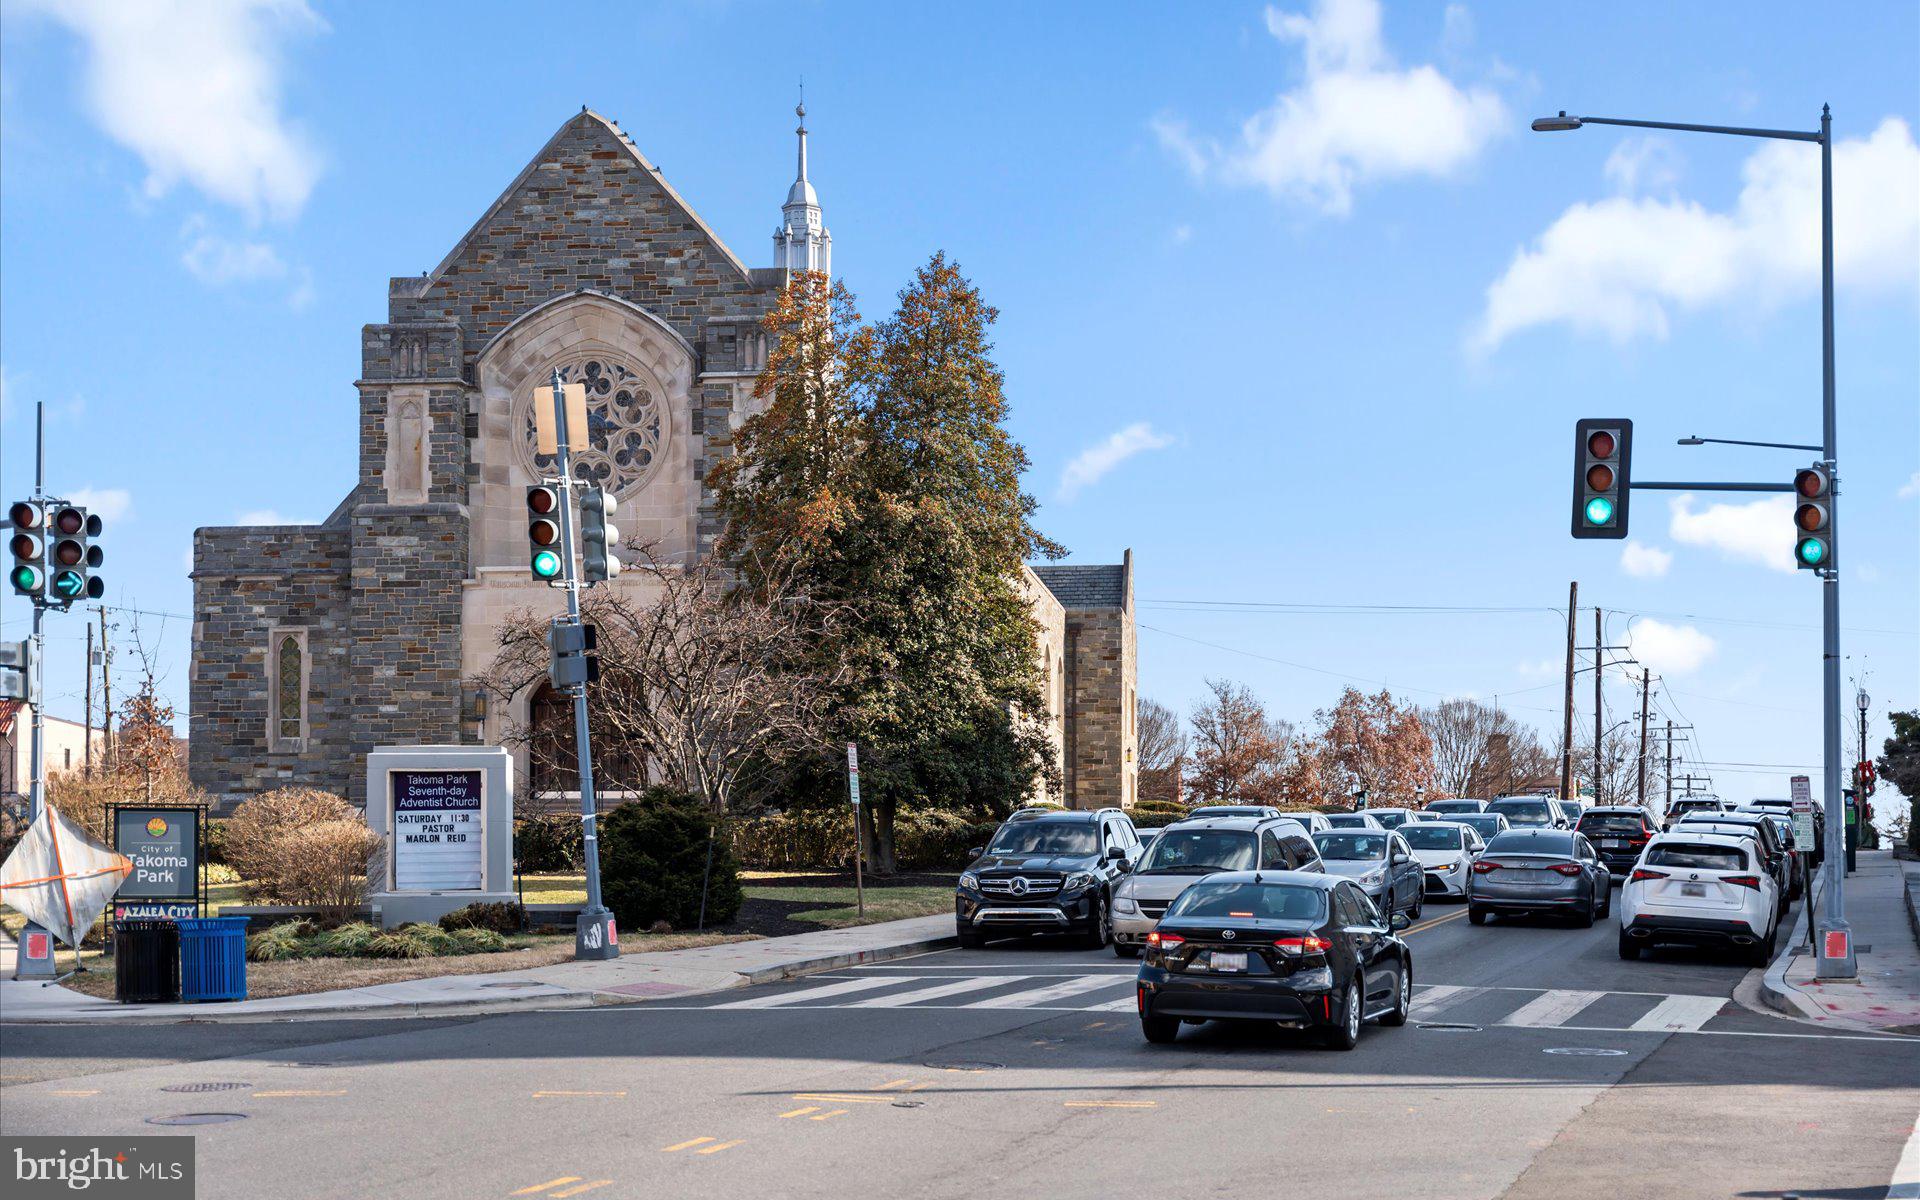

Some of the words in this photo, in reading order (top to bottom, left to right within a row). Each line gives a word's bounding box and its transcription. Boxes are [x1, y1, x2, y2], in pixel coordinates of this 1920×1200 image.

[407, 775, 443, 784] Takoma
[446, 774, 468, 784] Park
[408, 786, 467, 797] Seventh-day
[400, 798, 443, 807] Adventist
[445, 797, 478, 807] Church
[397, 814, 442, 823] SATURDAY
[450, 814, 469, 822] 11:30
[422, 825, 455, 833] PASTOR
[406, 834, 440, 843] MARLON
[447, 834, 466, 842] REID
[127, 854, 188, 867] Takoma
[137, 870, 174, 882] Park
[123, 905, 165, 919] AZALEA
[167, 905, 195, 919] CITY
